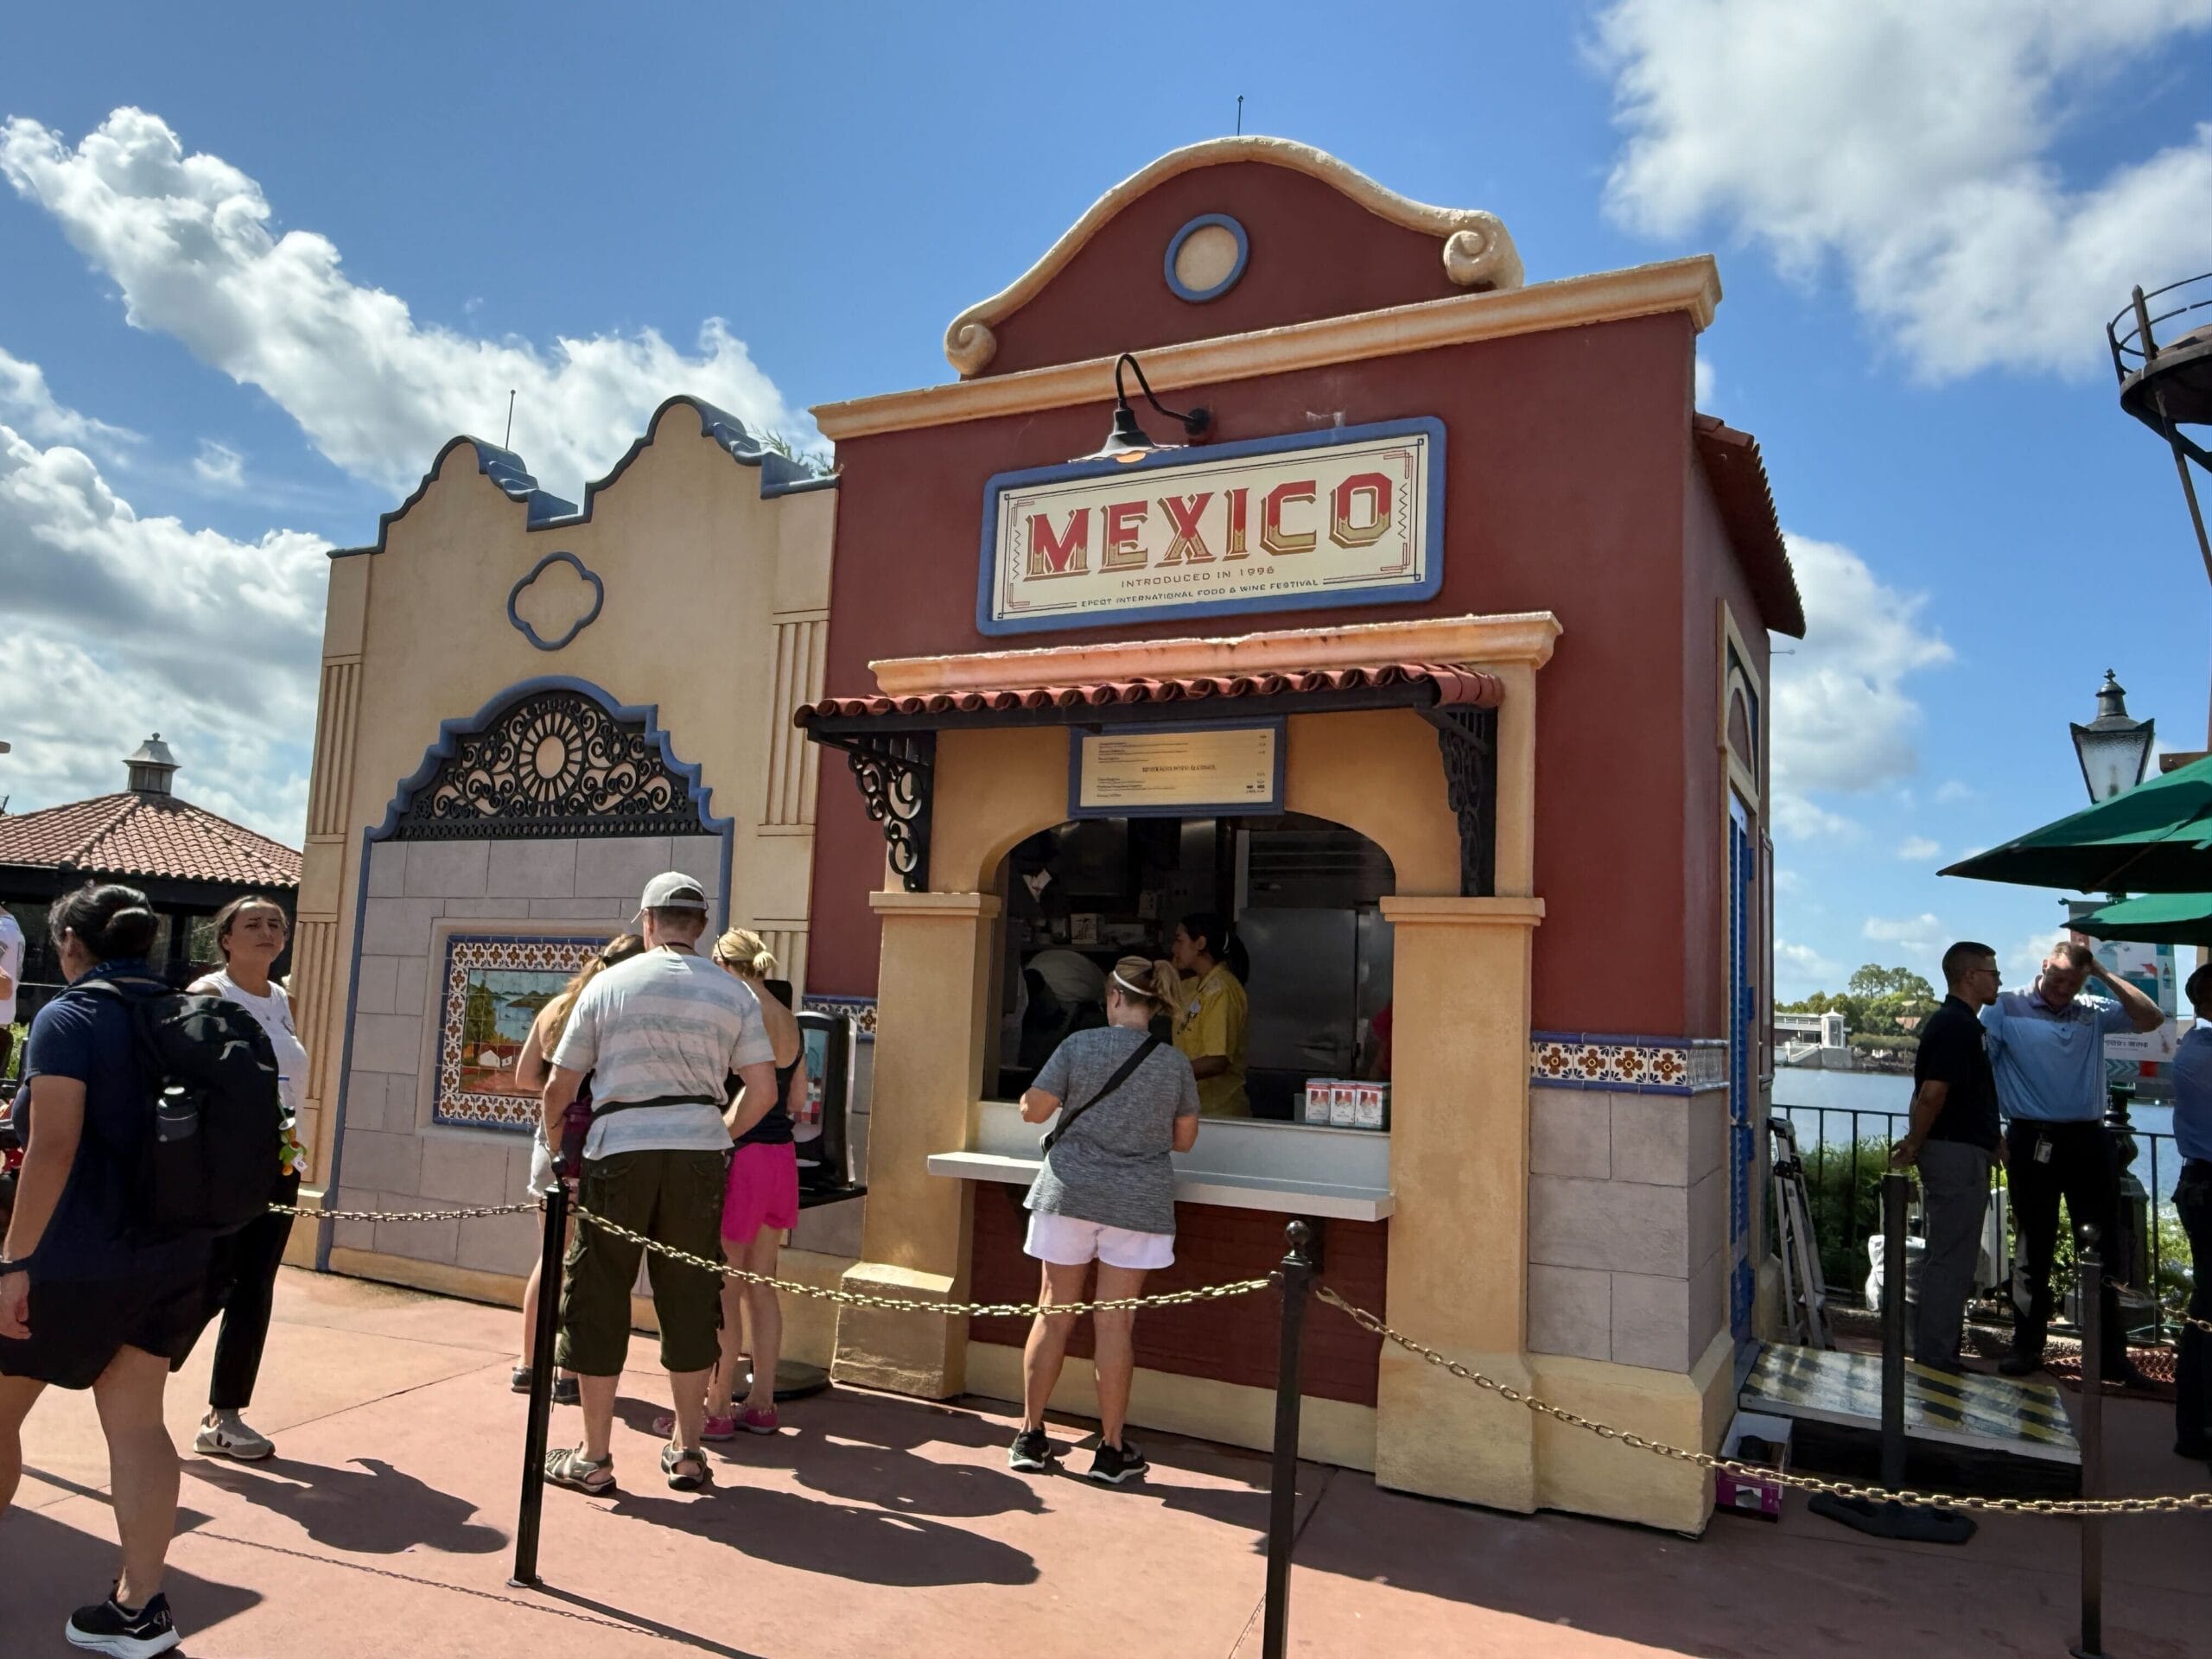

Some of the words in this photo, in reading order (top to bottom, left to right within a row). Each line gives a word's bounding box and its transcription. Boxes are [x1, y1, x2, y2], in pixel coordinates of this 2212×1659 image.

[1023, 472, 1394, 581] MEXICO
[1121, 572, 1211, 588] INTRODUCED
[1217, 570, 1231, 579] IN
[1240, 566, 1275, 576] 1996
[1081, 598, 1112, 607] EPCOT
[1116, 591, 1194, 604] INTERNATIONAL
[1197, 588, 1225, 596] FOOD
[1240, 583, 1266, 593] WINE
[1269, 579, 1319, 591] FESTIVAL
